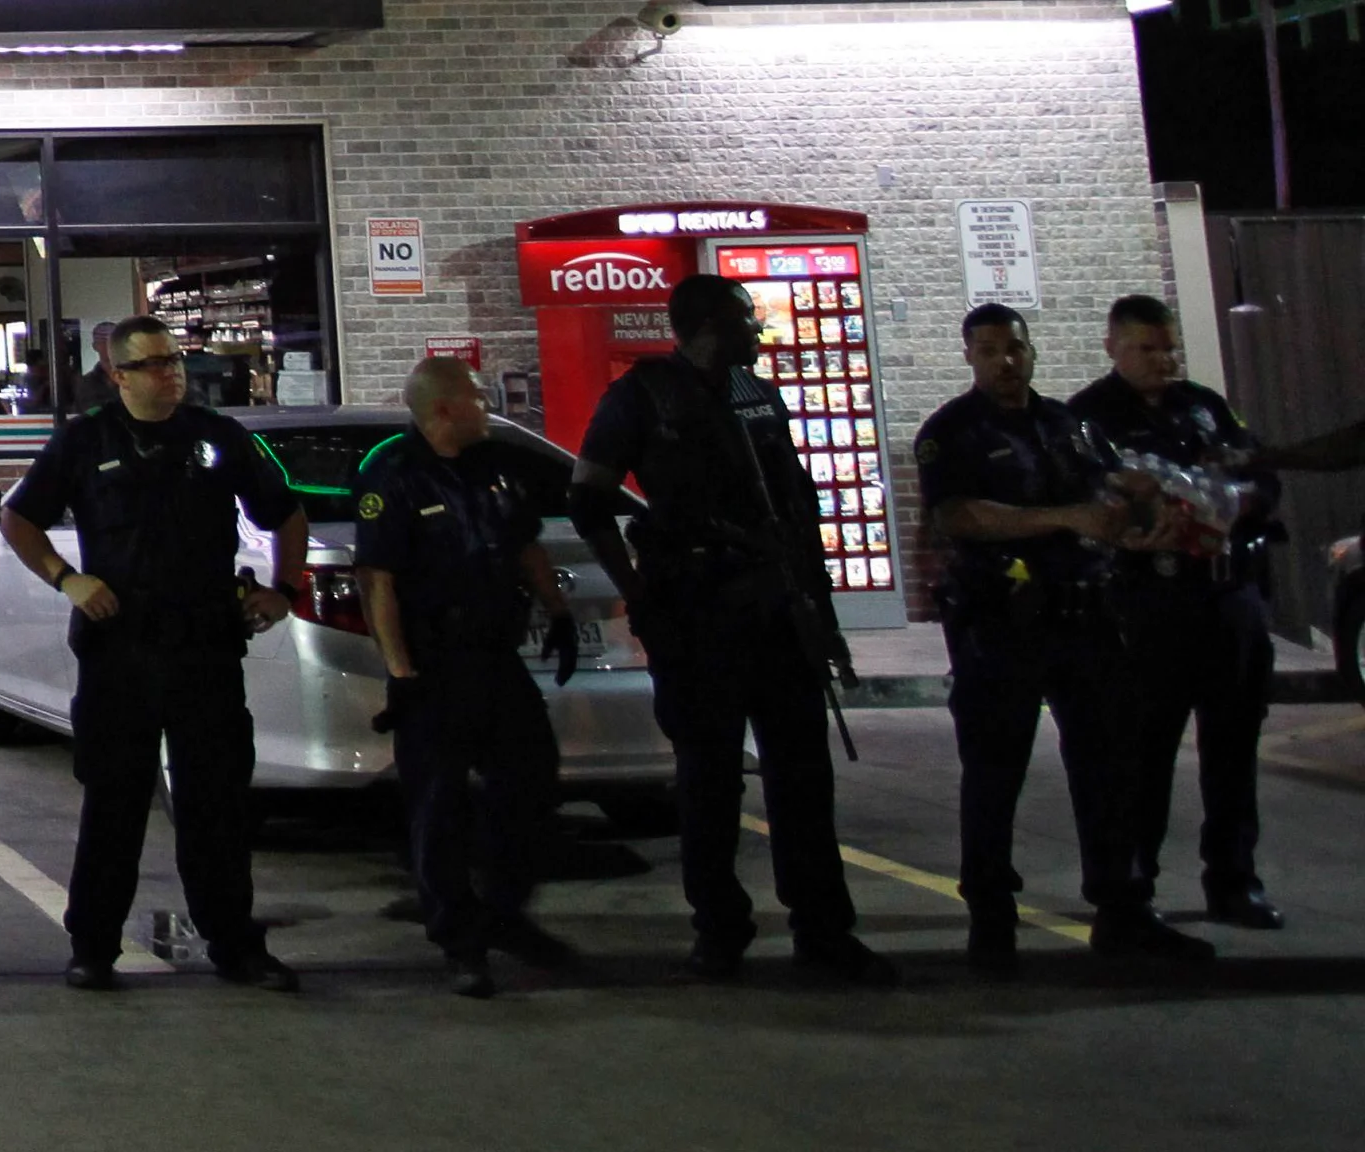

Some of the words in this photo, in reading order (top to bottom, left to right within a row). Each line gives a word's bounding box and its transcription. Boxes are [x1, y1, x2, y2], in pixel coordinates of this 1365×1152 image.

[370, 221, 418, 229] VIOLATION
[678, 210, 767, 230] RENTALS
[379, 243, 412, 260] NO
[550, 262, 667, 291] redbox
[614, 312, 651, 326] NEW
[615, 327, 661, 339] movies
